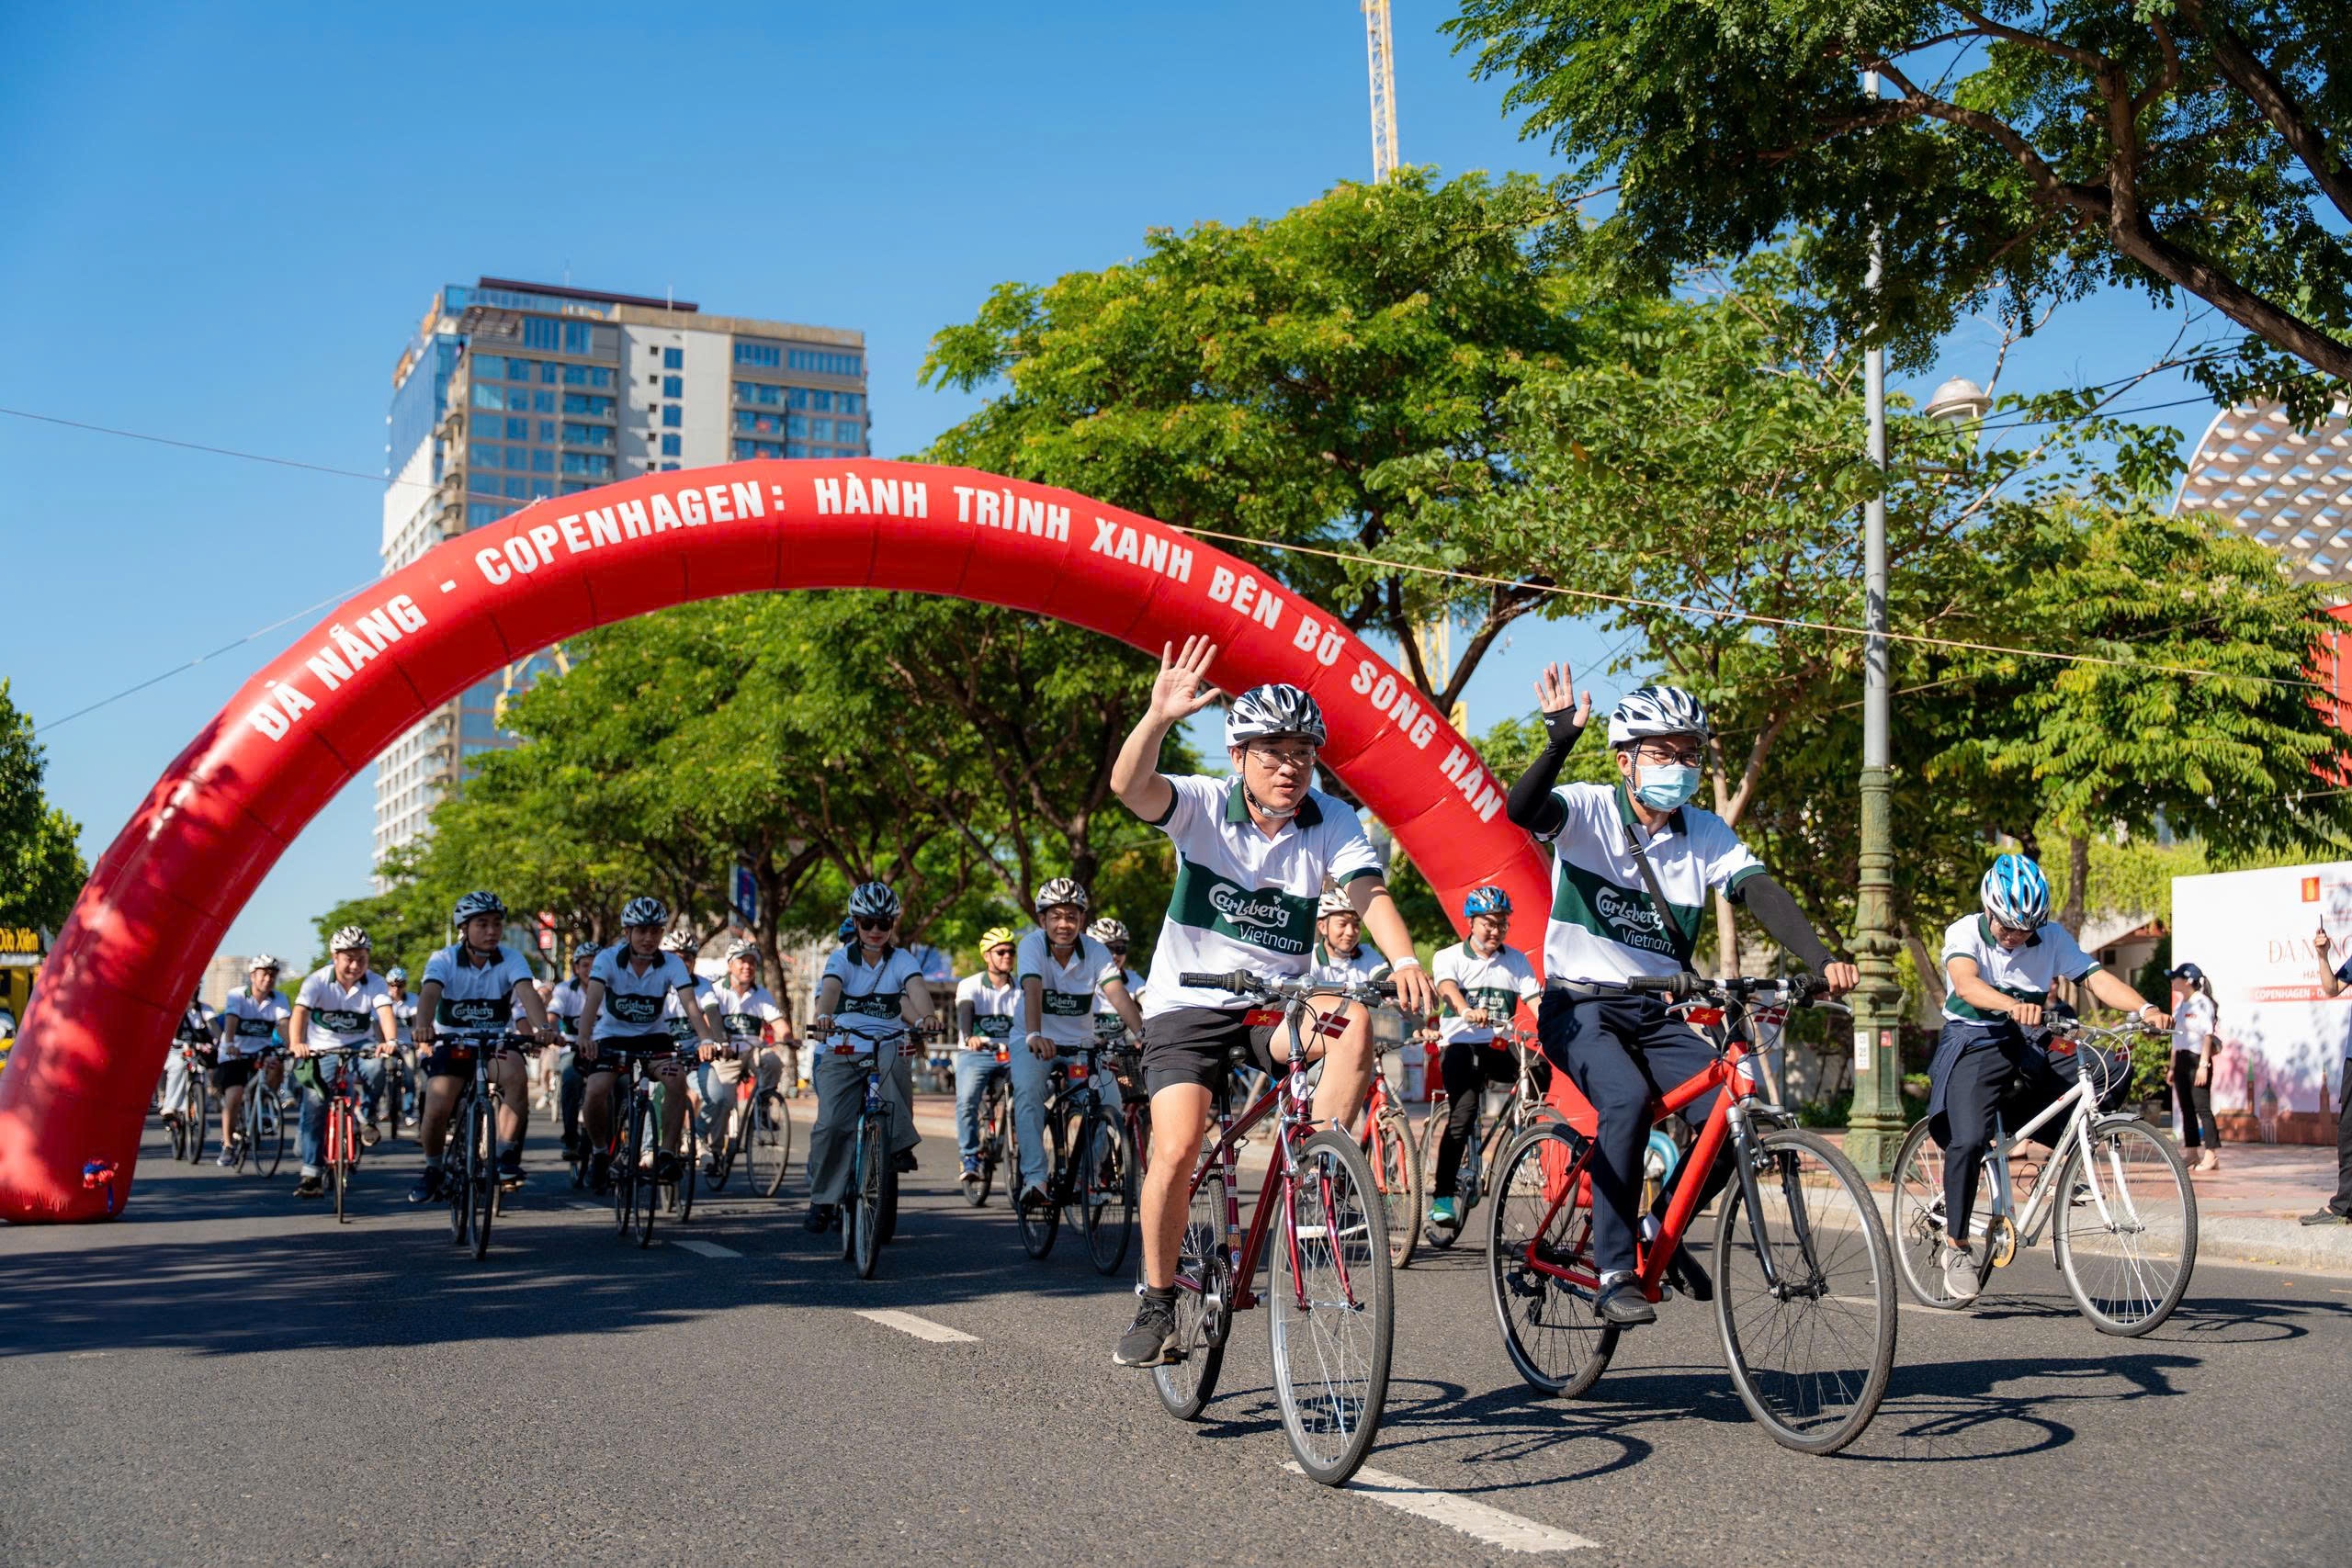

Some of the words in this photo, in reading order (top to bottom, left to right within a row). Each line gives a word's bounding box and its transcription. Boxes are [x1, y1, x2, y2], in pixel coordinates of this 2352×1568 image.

[245, 680, 317, 743] ĐÀ
[813, 471, 928, 519] HÀNH
[953, 485, 1071, 543] TRÌNH
[1089, 515, 1193, 584] XANH
[1206, 564, 1284, 631] BÊN
[1293, 614, 1347, 667] BỜ
[1350, 660, 1438, 750] SÔNG
[1208, 882, 1291, 928] Carlsberg
[1595, 886, 1665, 931] Carlsberg
[1239, 924, 1304, 953] Vietnam
[451, 1001, 494, 1020] Carlsberg
[616, 998, 655, 1015] Carlsberg
